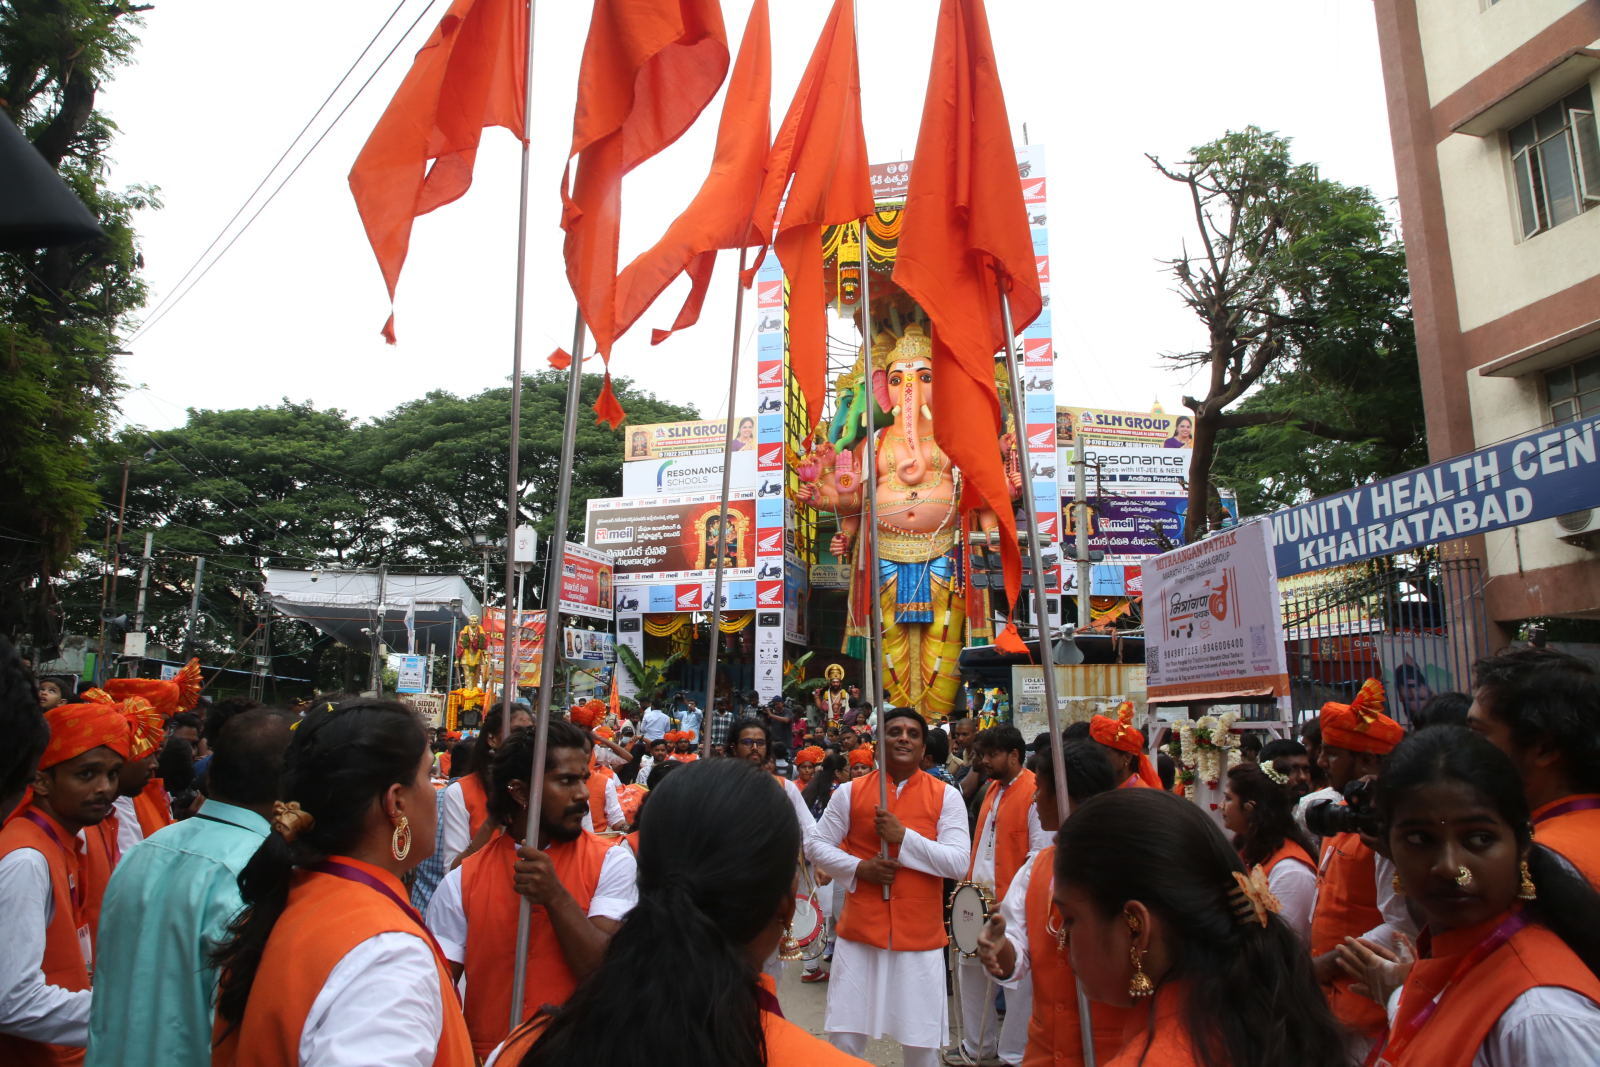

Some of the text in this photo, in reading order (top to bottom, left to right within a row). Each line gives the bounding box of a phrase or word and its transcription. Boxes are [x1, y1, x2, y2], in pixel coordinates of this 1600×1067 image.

[1096, 414, 1170, 430] SLN GROUP
[668, 424, 726, 438] SLN GROU
[1085, 452, 1183, 466] Resonance
[667, 466, 724, 478] RESONANCE
[1370, 451, 1500, 518] HEALTH
[1512, 422, 1600, 480] CEN
[667, 476, 708, 487] SCHOOLS
[1112, 519, 1133, 527] meil
[1298, 487, 1533, 568] KHAIRATABAD
[609, 528, 632, 538] meil
[1203, 531, 1237, 554] PATHAK
[644, 545, 666, 555] చవితి
[1212, 552, 1230, 565] GROUP
